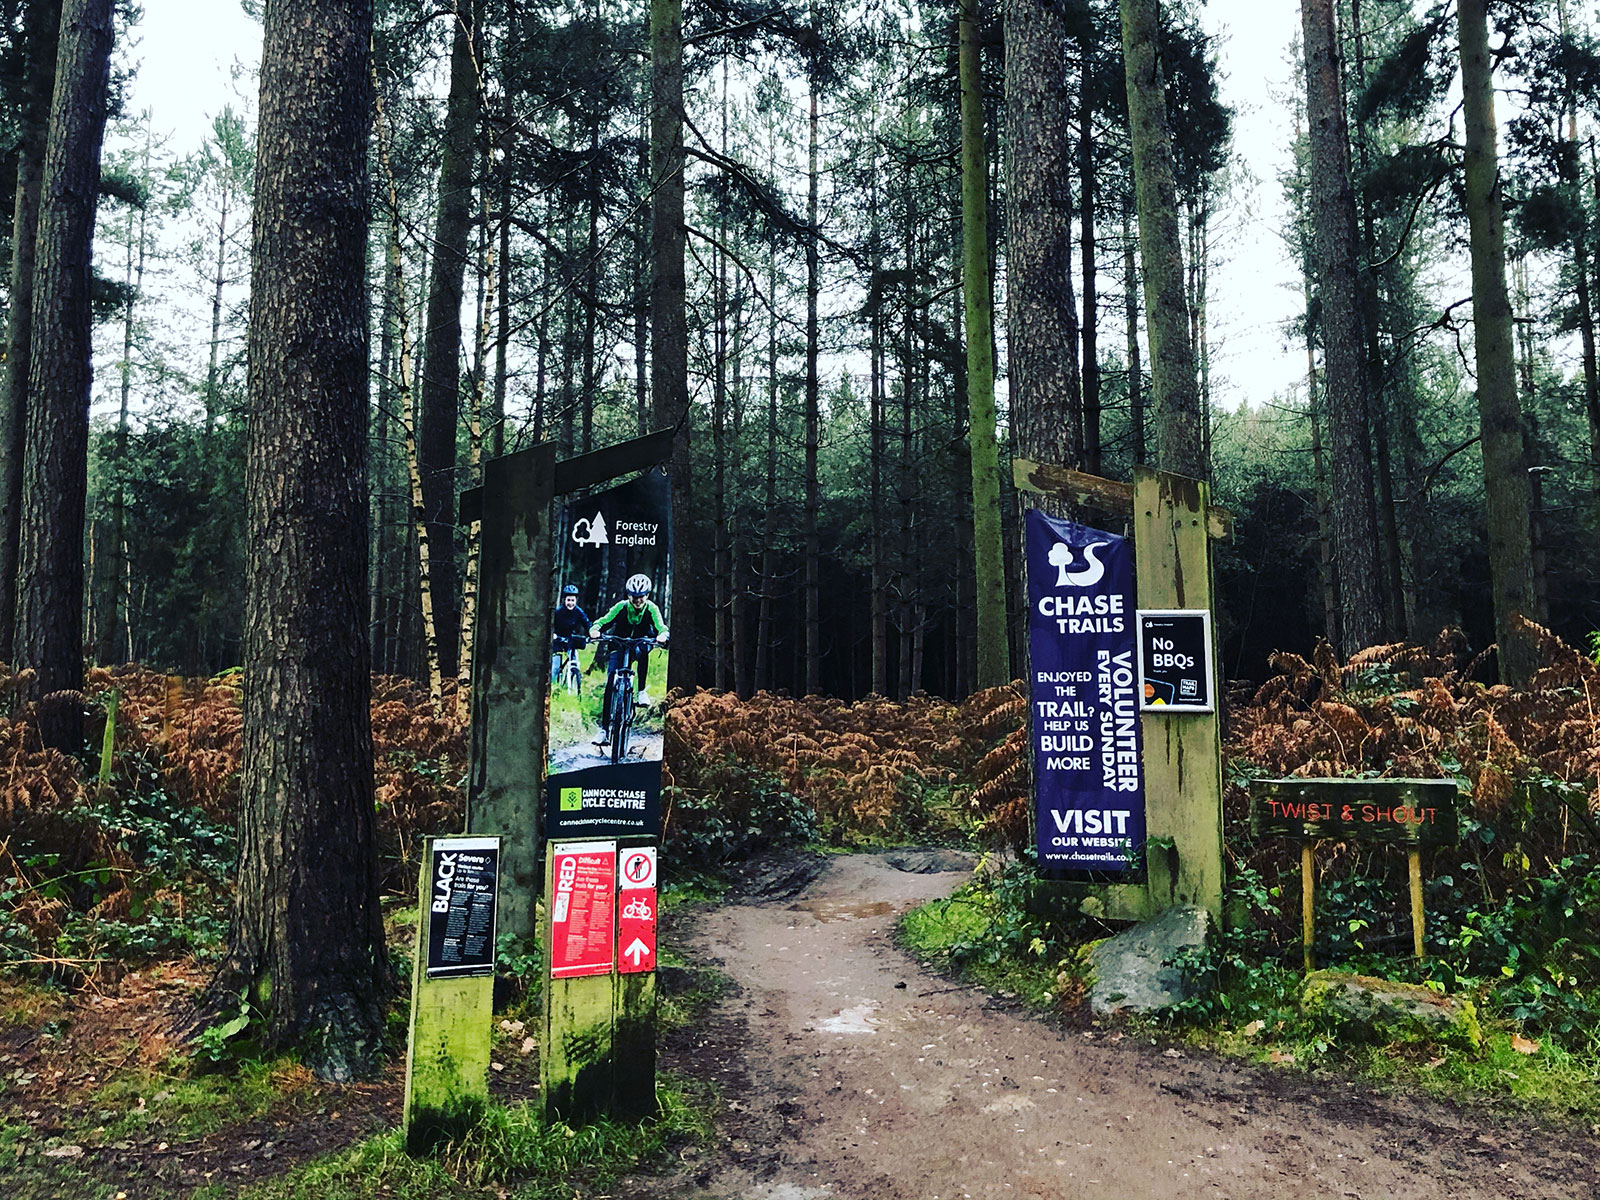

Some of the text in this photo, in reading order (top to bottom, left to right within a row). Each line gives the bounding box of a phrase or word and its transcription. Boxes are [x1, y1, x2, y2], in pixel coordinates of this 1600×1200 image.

[616, 521, 658, 533] Forestry
[615, 534, 656, 547] England
[1038, 594, 1124, 616] CHASE
[1056, 617, 1125, 634] TRAILS
[1152, 637, 1174, 650] No
[1153, 653, 1195, 670] BBQs
[1037, 671, 1092, 682] ENJOYED
[1055, 686, 1076, 696] THE
[1037, 701, 1095, 717] TRAIL?
[1044, 721, 1089, 731] HELP US
[1097, 650, 1116, 791] EVERY SUNDAY
[1112, 650, 1138, 792] VOLUNTEER
[1041, 735, 1094, 751] BUILD
[1046, 757, 1091, 770] MORE
[583, 789, 646, 799] CANNOCK CHASE
[583, 798, 646, 810] CYCLE CENTRE
[1268, 801, 1437, 825] TWIST & SHOUT
[1050, 809, 1131, 834] VISIT
[1051, 837, 1132, 848] OUR WEBSITE
[458, 853, 485, 864] Severe
[1045, 851, 1135, 862] www.chasetrails.co.
[558, 857, 576, 891] RED
[432, 852, 457, 913] BLACK
